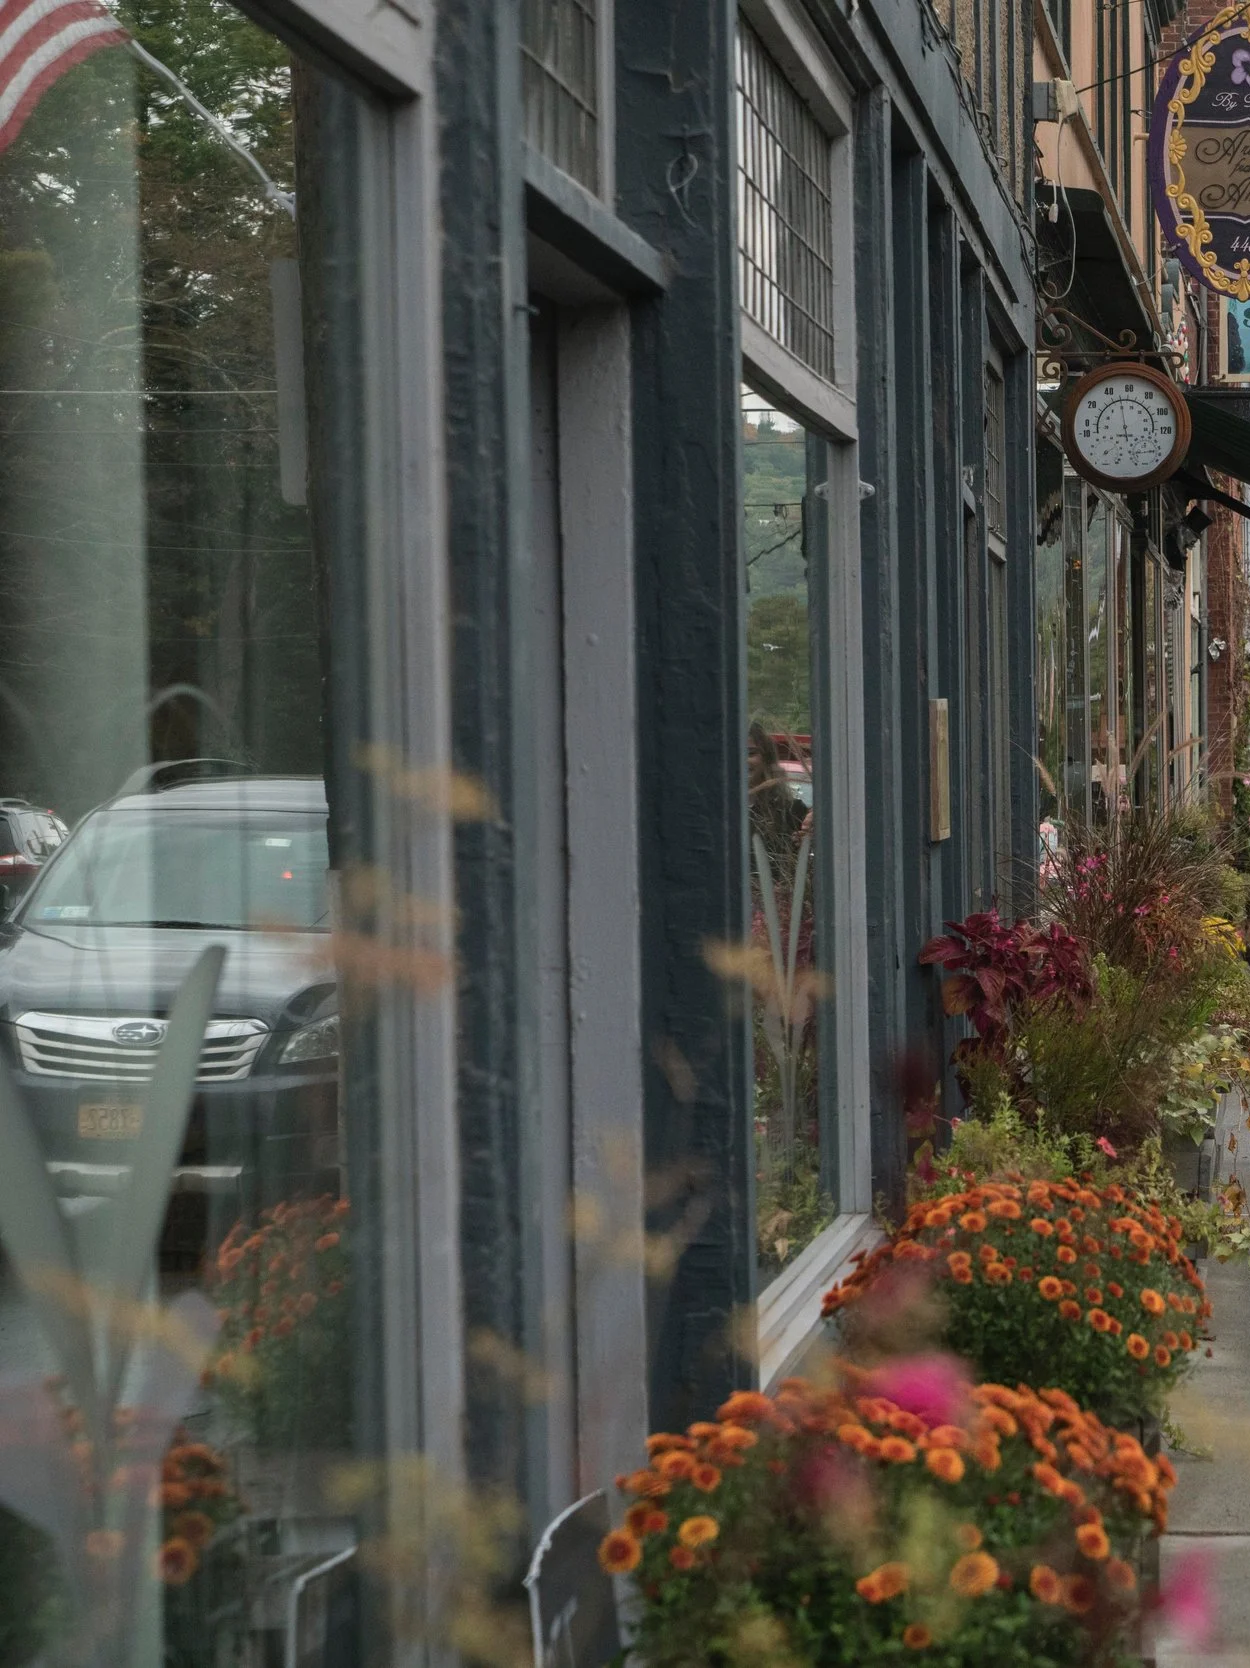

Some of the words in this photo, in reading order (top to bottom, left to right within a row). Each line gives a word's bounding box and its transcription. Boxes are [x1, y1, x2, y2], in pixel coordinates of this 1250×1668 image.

[1211, 91, 1240, 112] By
[1104, 387, 1114, 396] 40
[1124, 384, 1134, 393] 60
[1144, 391, 1154, 400] 80
[1087, 400, 1097, 409] 20
[1156, 407, 1169, 416] 100
[1084, 419, 1090, 427] 0
[1160, 426, 1172, 435] 120
